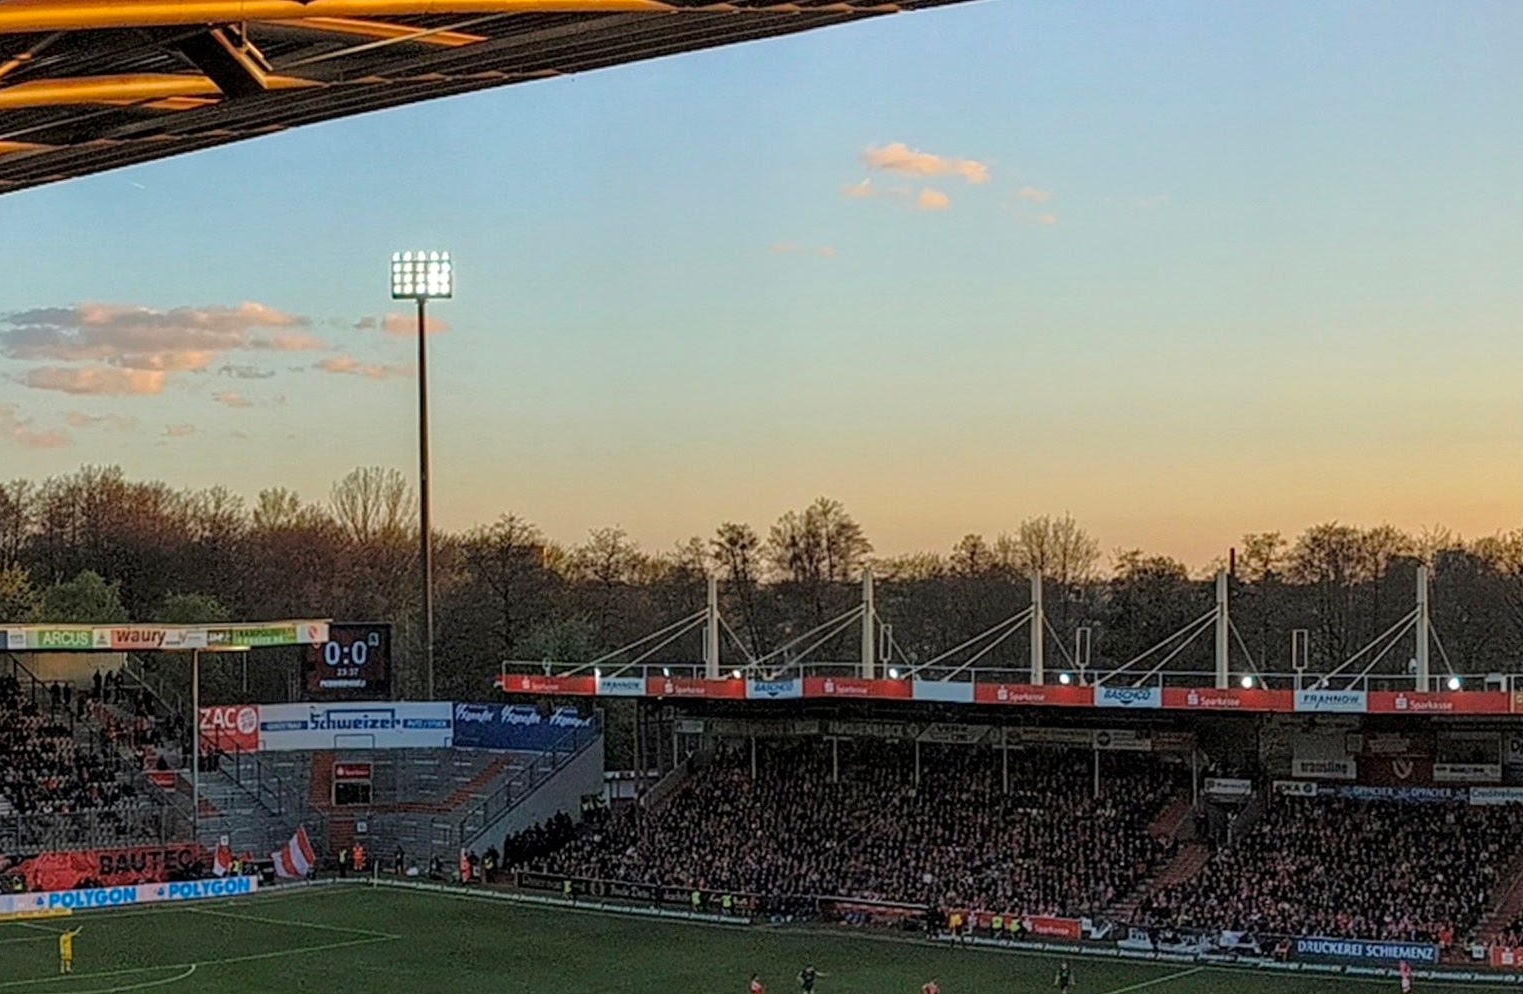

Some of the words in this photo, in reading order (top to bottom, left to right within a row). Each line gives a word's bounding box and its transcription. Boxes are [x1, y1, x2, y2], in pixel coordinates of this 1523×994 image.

[42, 632, 89, 646] ARCUS
[116, 629, 166, 647] waury
[324, 640, 368, 666] 0:0
[1199, 695, 1241, 708] Sparkasse
[1408, 699, 1453, 712] Sparkasse
[309, 711, 401, 730] Schweizer
[48, 886, 137, 908] POLYGON
[168, 878, 251, 899] POLYGON
[1297, 940, 1363, 957] DRUCKEREI
[1365, 943, 1435, 961] SCHIEMENZ
